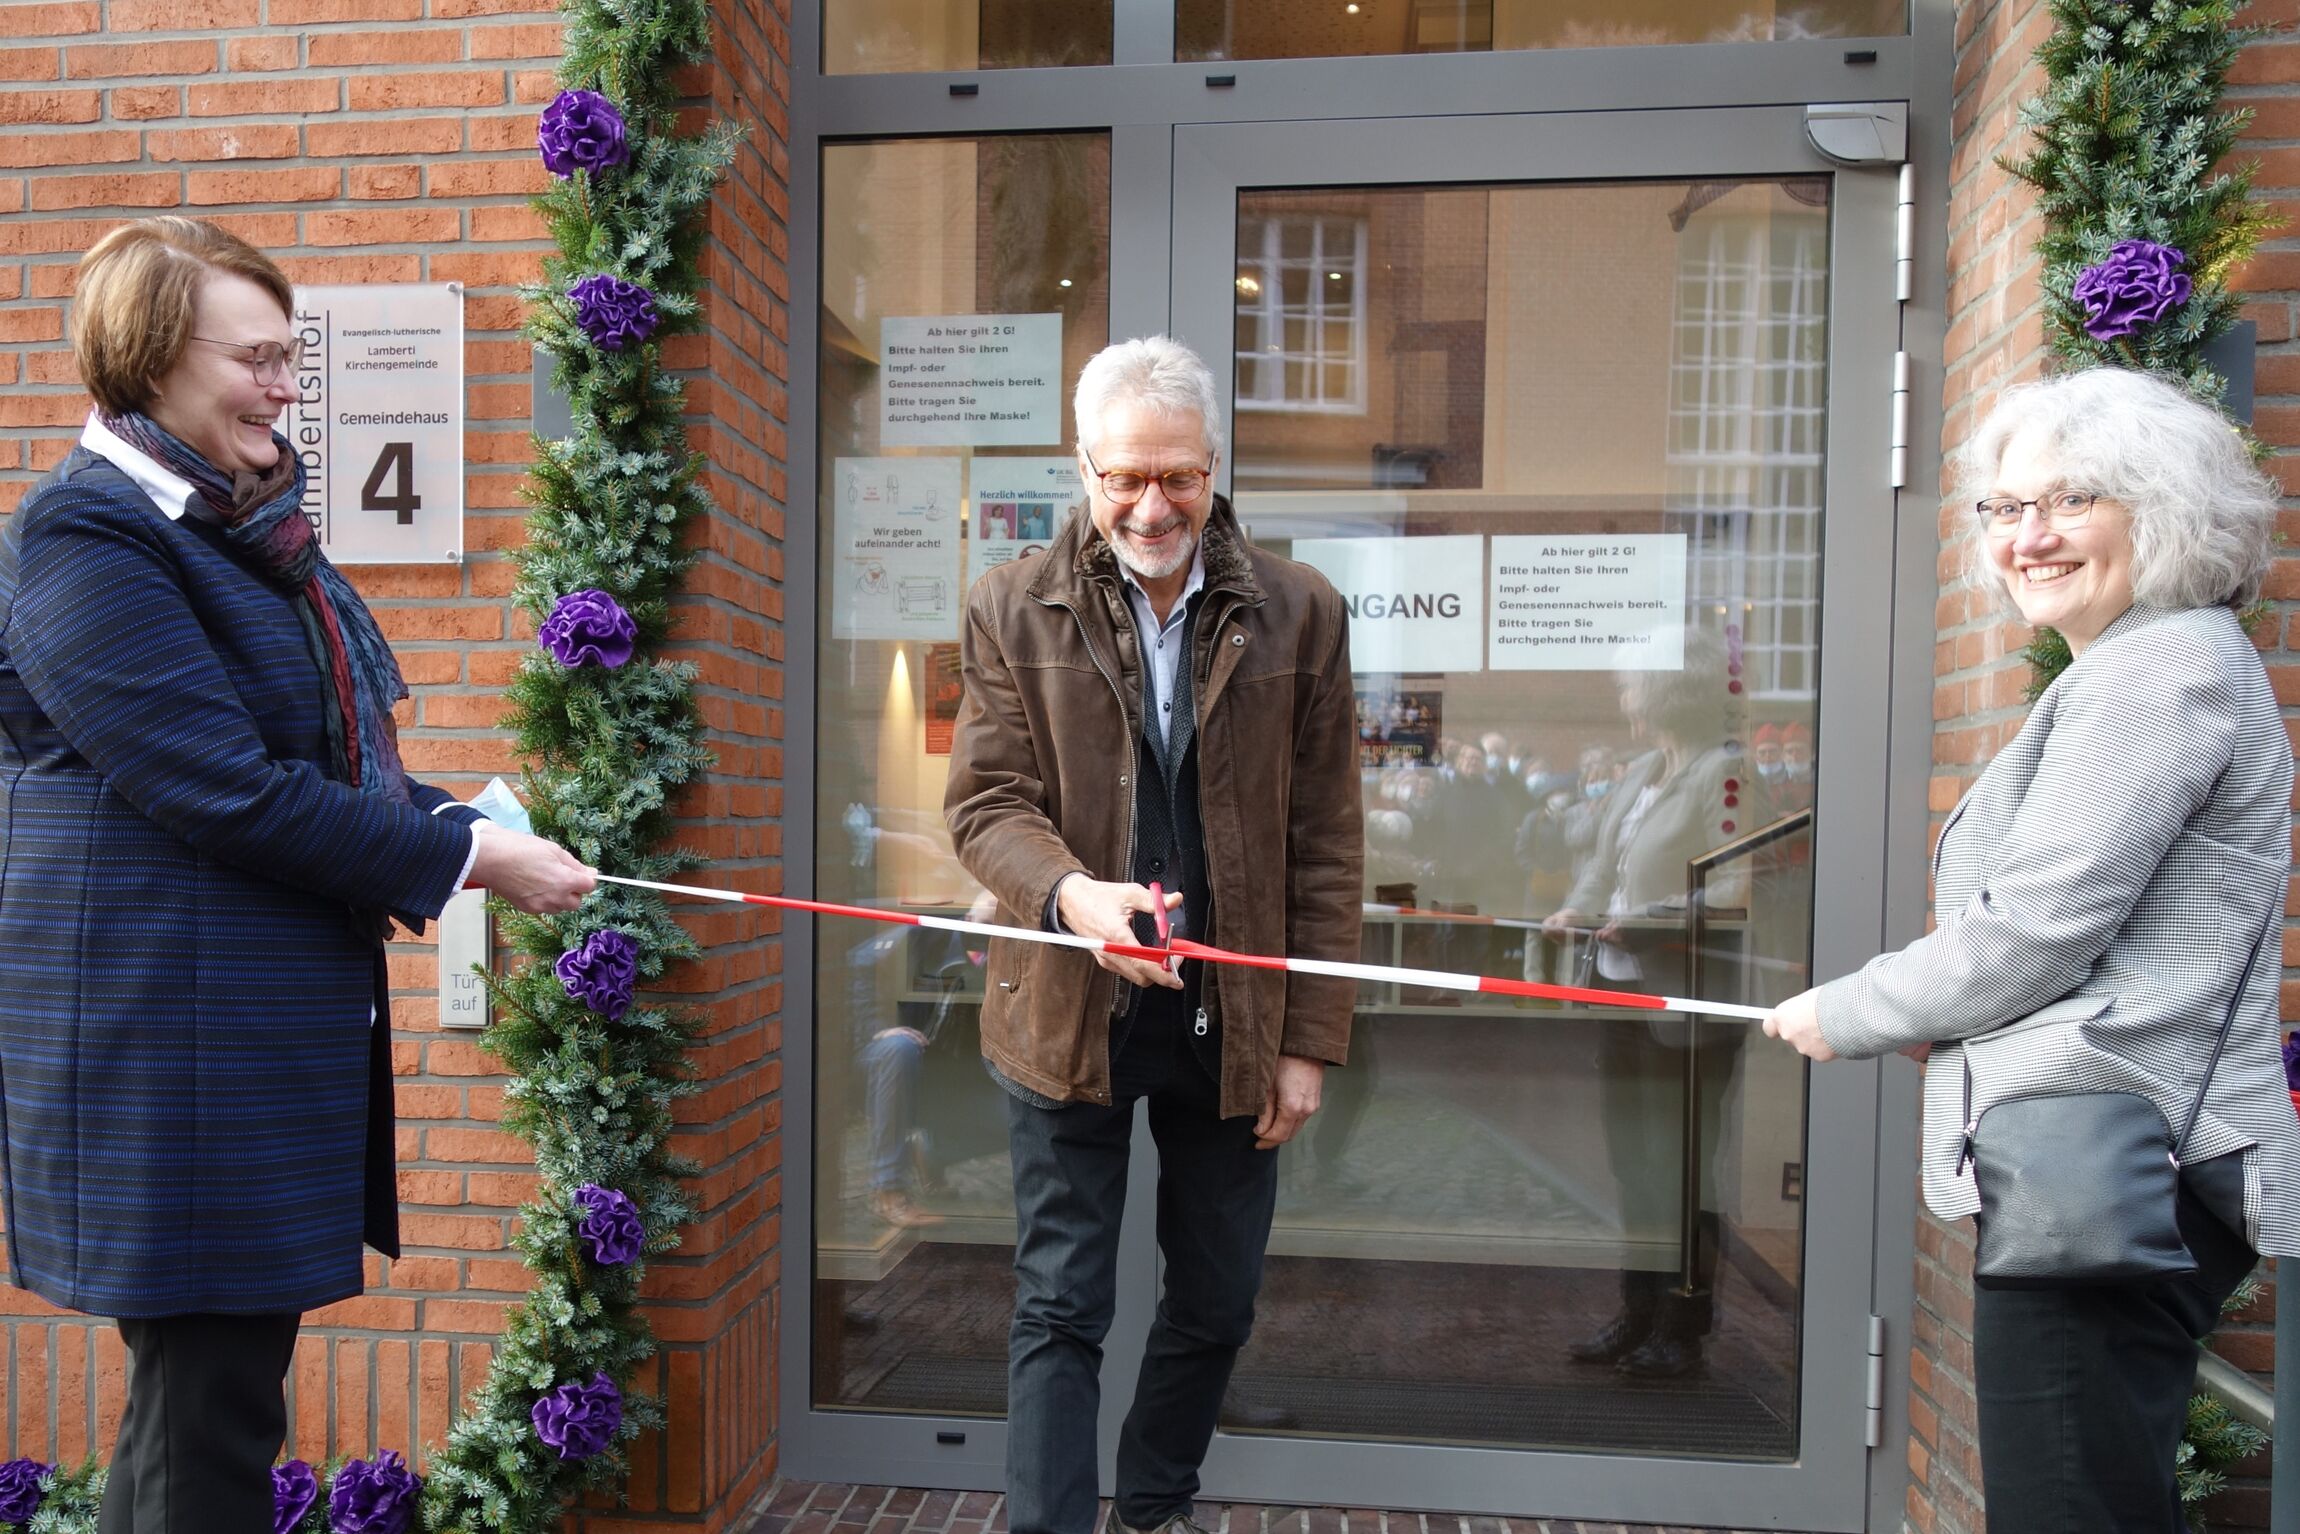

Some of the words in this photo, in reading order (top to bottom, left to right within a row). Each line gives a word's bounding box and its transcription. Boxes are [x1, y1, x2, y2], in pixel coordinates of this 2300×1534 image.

[342, 328, 442, 337] Evangelisch-lutherische
[927, 328, 942, 336] Ab
[945, 327, 968, 336] hier
[970, 327, 989, 338] gilt
[992, 326, 1000, 335] 2
[1003, 326, 1015, 335] G!
[367, 345, 416, 356] Lamberti
[888, 345, 916, 355] Bitte
[919, 345, 955, 354] halten
[958, 345, 976, 354] Sie
[979, 345, 1009, 353] Ihren
[345, 360, 439, 371] Kirchengemeinde
[888, 364, 917, 374] Impf-
[920, 363, 946, 373] oder
[888, 378, 1005, 388] Genesenennachweis
[1008, 377, 1045, 387] bereit.
[888, 397, 916, 406] Bitte
[919, 397, 955, 407] tragen
[958, 396, 977, 405] Sie
[339, 411, 449, 425] Gemeindehaus
[888, 412, 961, 423] durchgehend
[964, 412, 987, 421] Ihre
[989, 411, 1031, 420] Maske!
[361, 442, 421, 524] 4
[980, 490, 1016, 499] Herzlich
[1018, 490, 1073, 499] willkommen!
[873, 527, 890, 536] Wir
[892, 527, 922, 538] geben
[855, 539, 913, 548] aufeinander
[916, 539, 941, 548] acht!
[1541, 547, 1558, 556] Ab
[1561, 547, 1584, 556] hier
[1588, 547, 1608, 558] gilt
[1611, 547, 1619, 556] 2
[1623, 546, 1636, 556] G!
[1500, 566, 1529, 575] Bitte
[1532, 566, 1570, 575] halten
[1574, 565, 1593, 575] Sie
[1597, 565, 1629, 574] Ihren
[1499, 584, 1530, 595] Impf-
[1533, 584, 1561, 593] oder
[1499, 600, 1624, 610] Genesenennachweis
[1628, 600, 1668, 609] bereit.
[1498, 619, 1528, 628] Bitte
[1531, 619, 1571, 630] tragen
[1574, 618, 1593, 627] Sie
[1498, 635, 1576, 646] durchgehend
[1580, 635, 1604, 644] Ihre
[1608, 635, 1651, 644] Maske!
[451, 974, 478, 989] Tür
[451, 996, 477, 1011] auf
